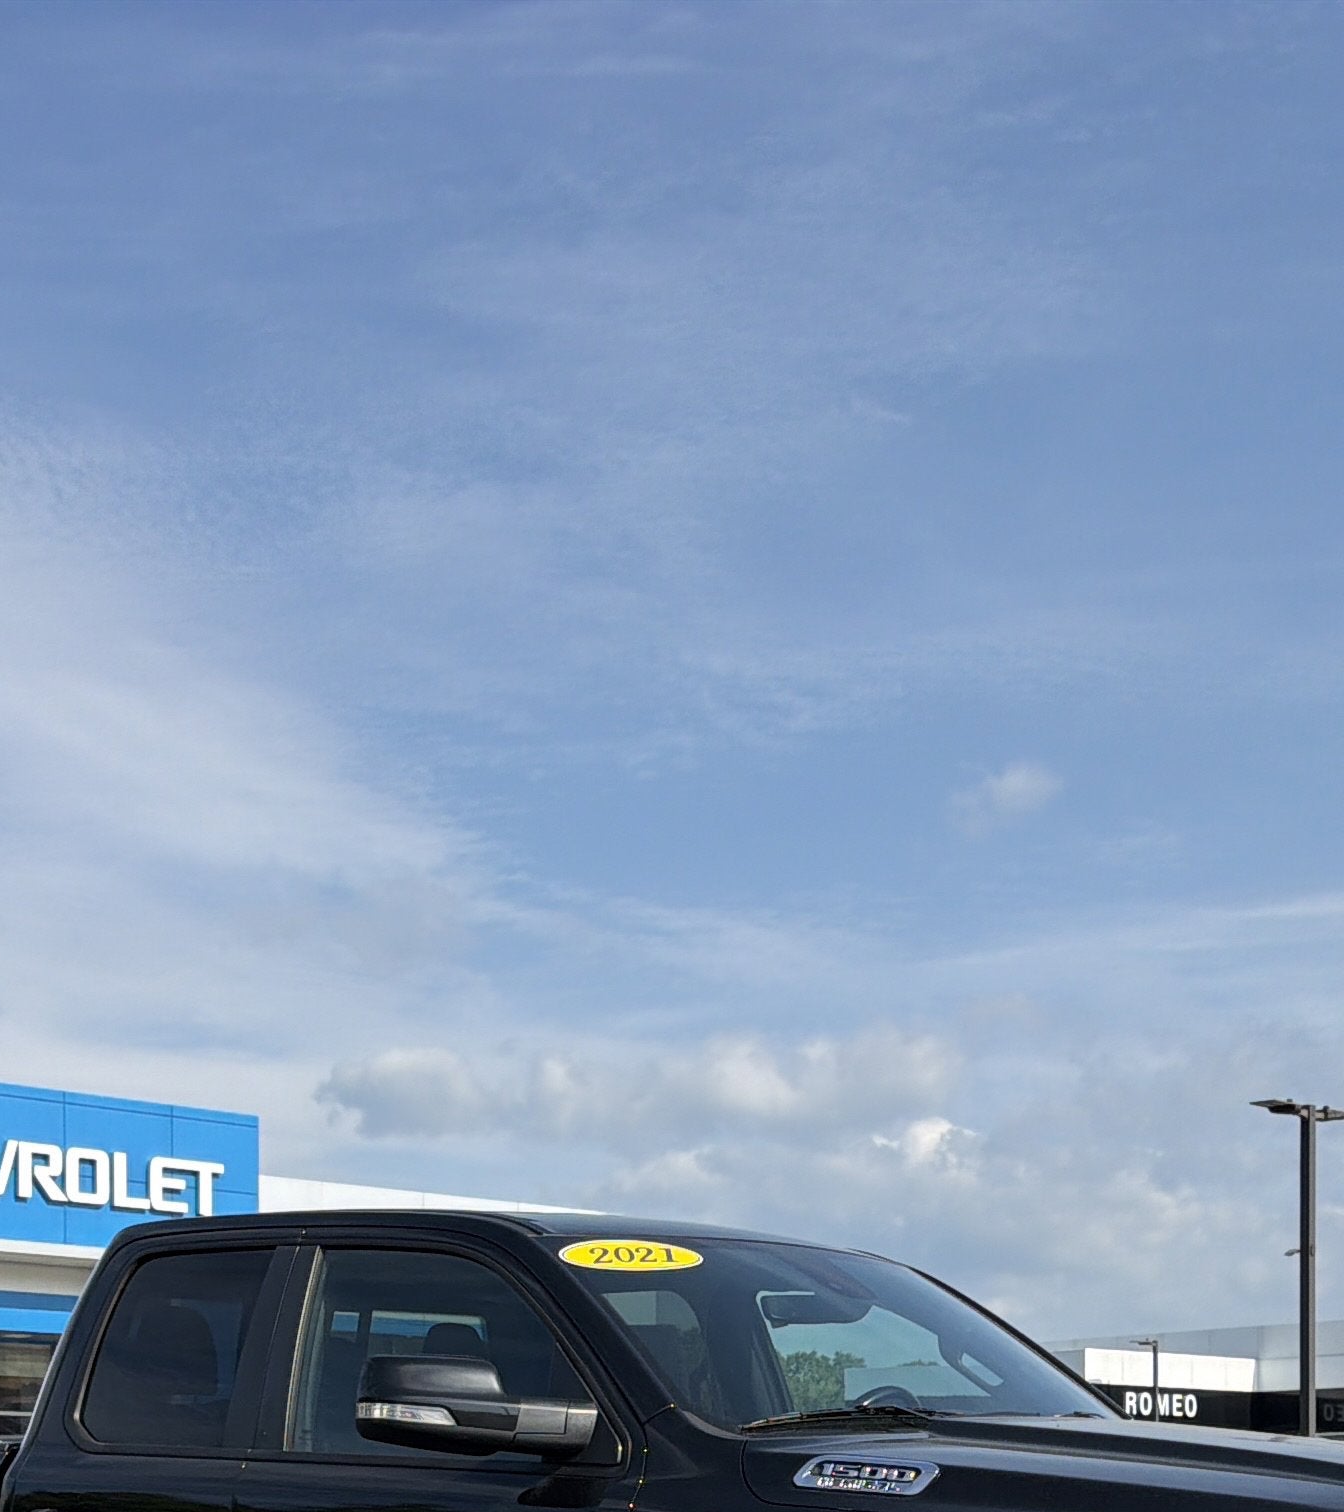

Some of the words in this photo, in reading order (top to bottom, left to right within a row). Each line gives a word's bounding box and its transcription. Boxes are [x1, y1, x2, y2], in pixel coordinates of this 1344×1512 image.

[589, 1247, 678, 1264] 2021
[1125, 1391, 1198, 1418] ROMEO
[821, 1463, 917, 1482] 1500
